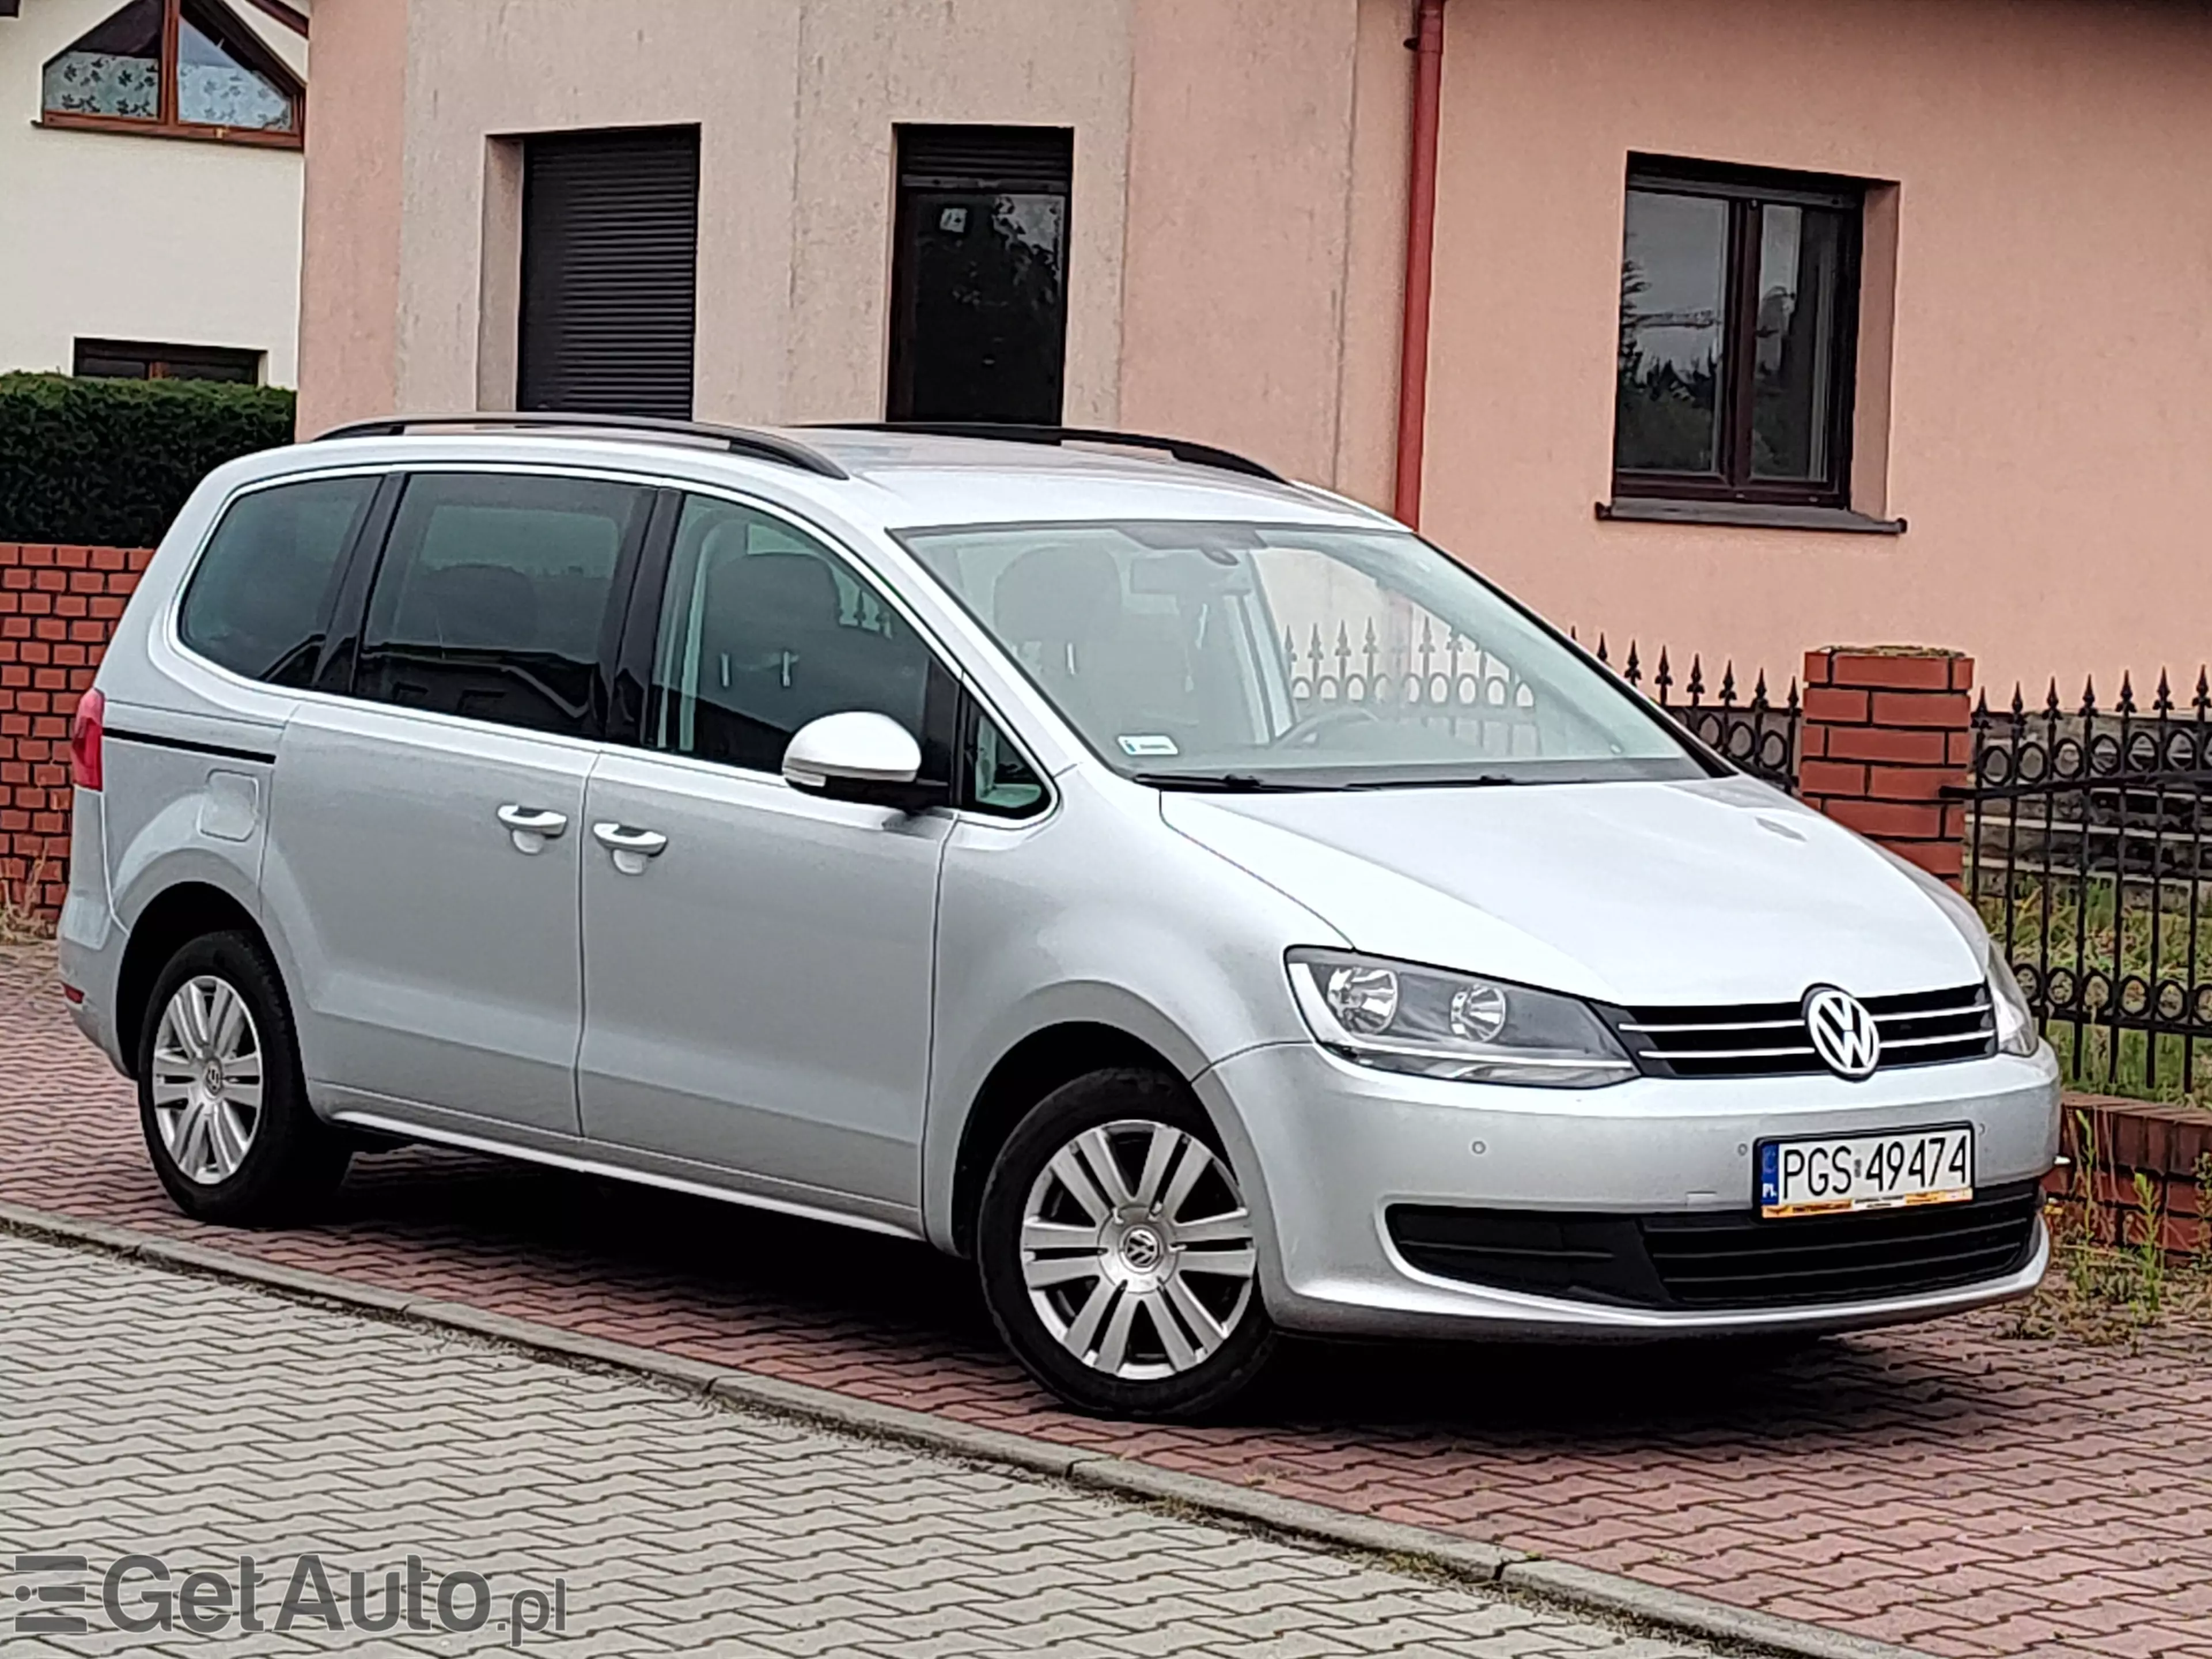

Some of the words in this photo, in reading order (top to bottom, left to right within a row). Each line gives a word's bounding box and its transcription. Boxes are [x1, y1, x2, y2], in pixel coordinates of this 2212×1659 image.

[1809, 990, 1880, 1075] VW
[1783, 1145, 1852, 1199] PGS
[1865, 1135, 1967, 1192] 49474
